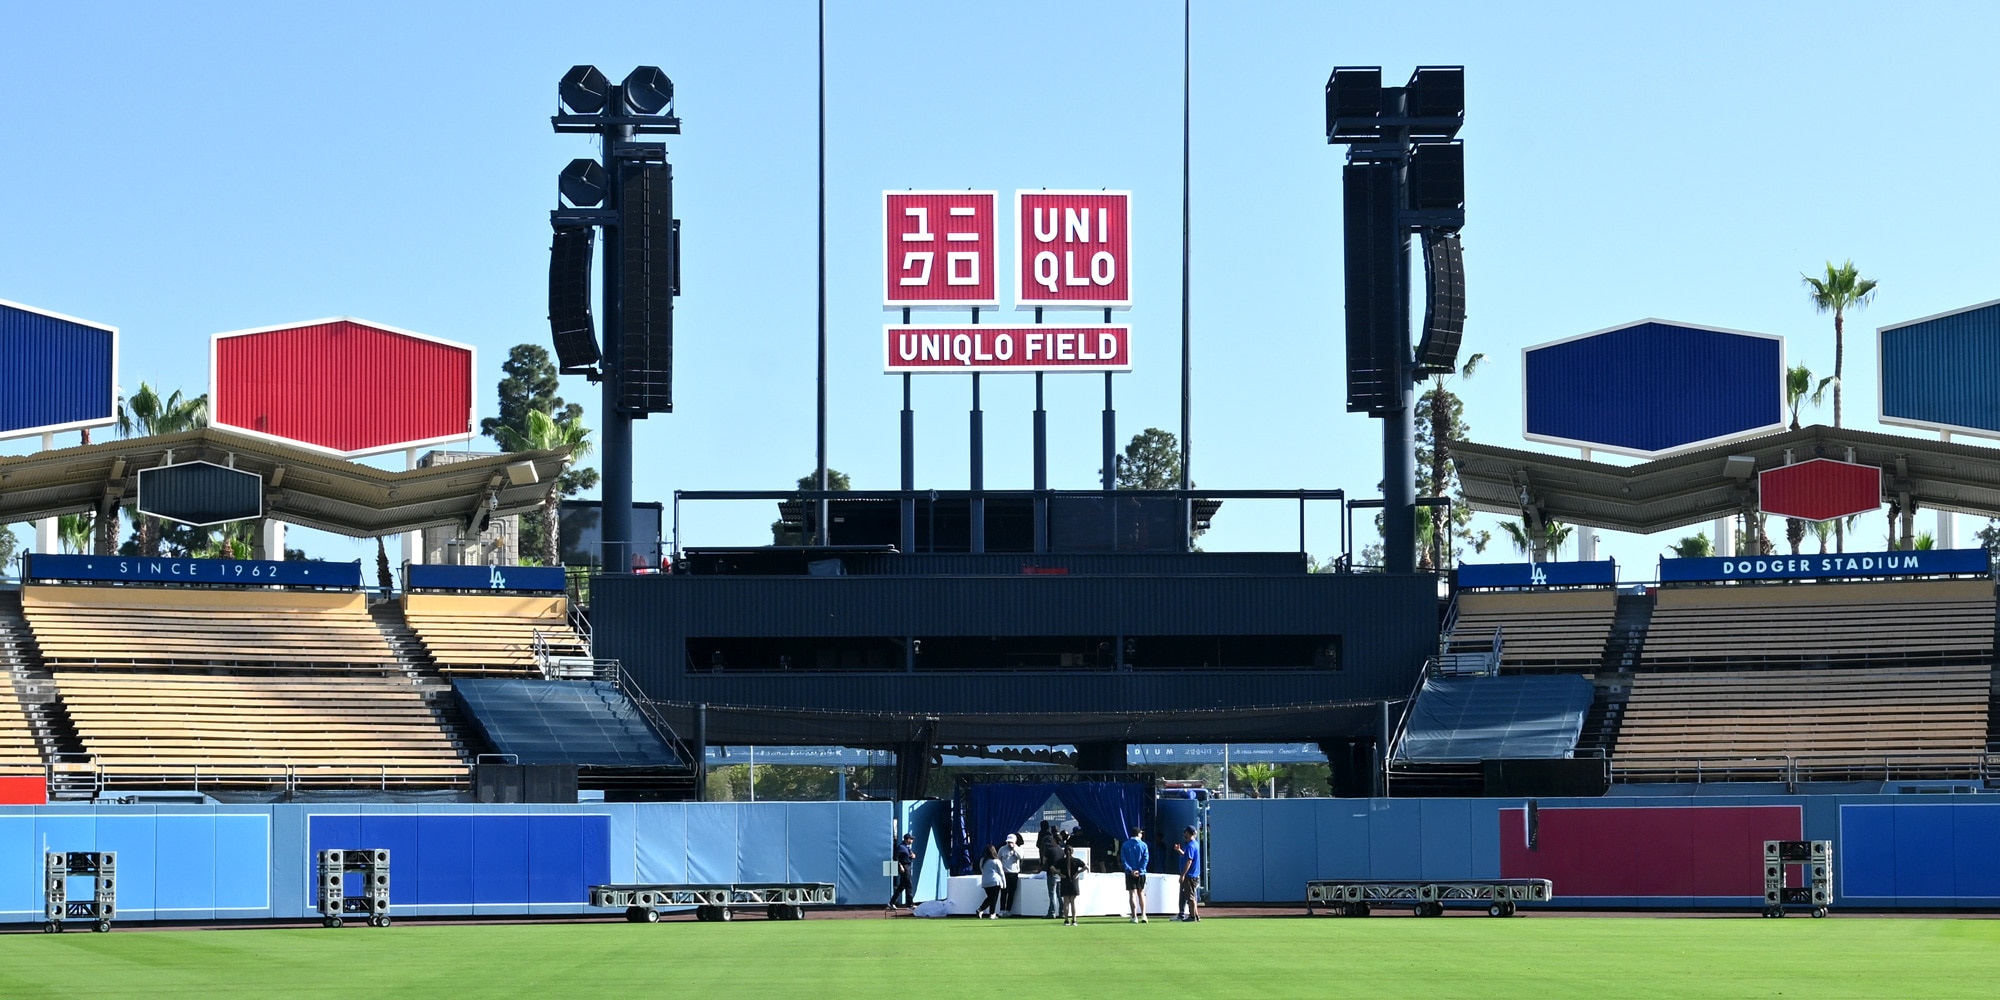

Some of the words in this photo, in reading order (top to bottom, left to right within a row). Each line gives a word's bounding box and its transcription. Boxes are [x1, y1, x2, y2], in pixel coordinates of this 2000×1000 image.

[900, 207, 979, 242] ユニ
[1033, 207, 1108, 243] UNI
[900, 251, 980, 286] クロ
[1033, 250, 1116, 293] QLO
[899, 333, 1013, 365] UNIQLO
[1025, 333, 1118, 361] FIELD
[120, 561, 199, 576] SINCE
[220, 564, 278, 578] 1962
[489, 565, 506, 589] LA
[1530, 563, 1547, 586] LA
[1723, 558, 1812, 575] DODGER
[1821, 555, 1920, 572] STADIUM
